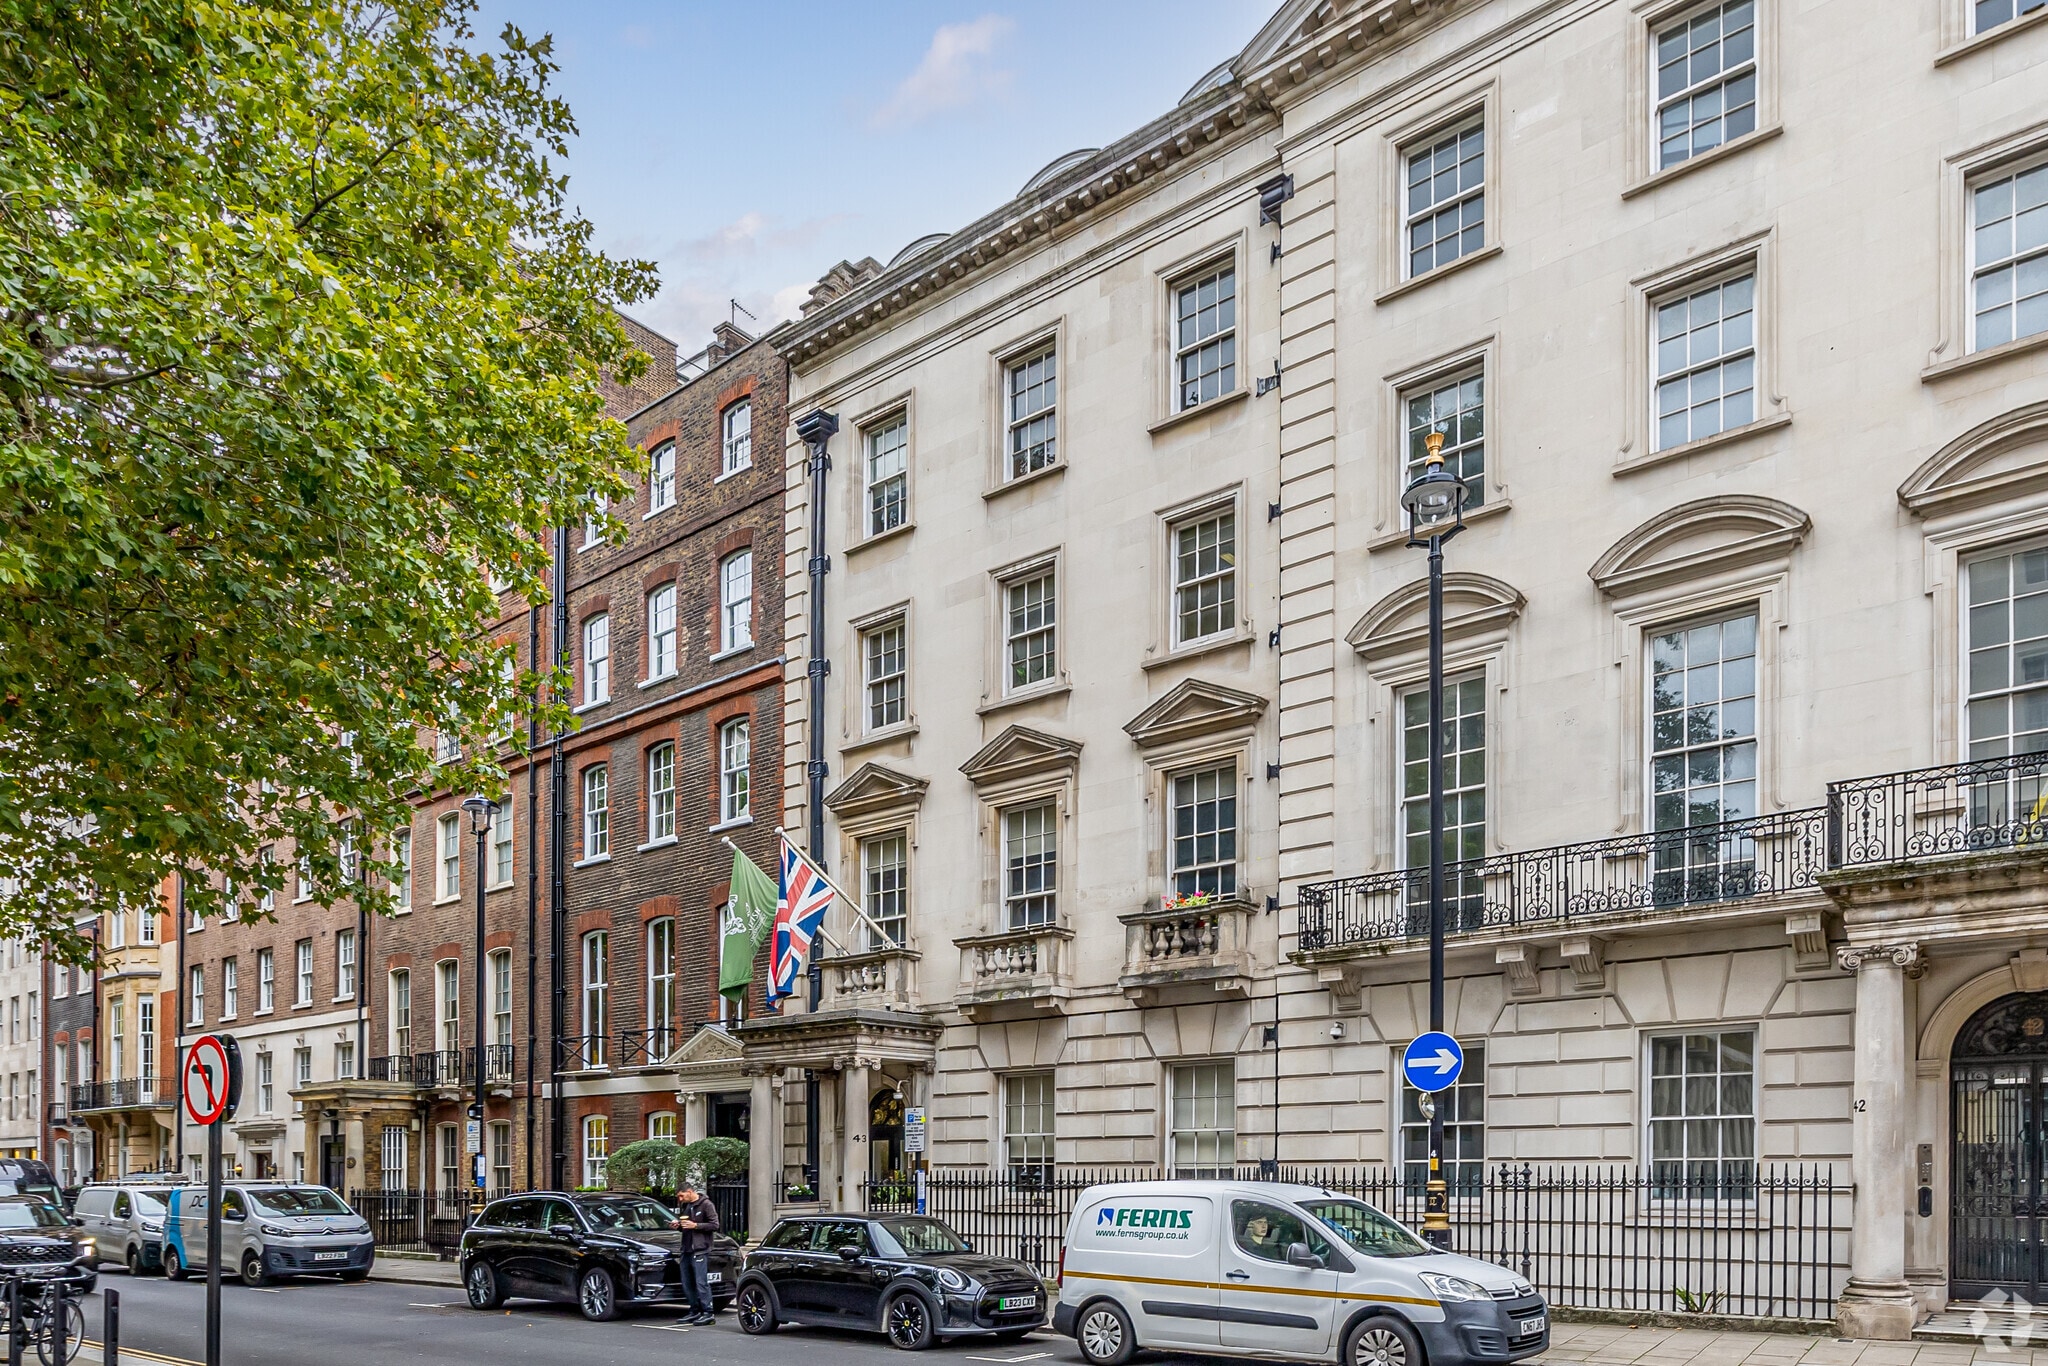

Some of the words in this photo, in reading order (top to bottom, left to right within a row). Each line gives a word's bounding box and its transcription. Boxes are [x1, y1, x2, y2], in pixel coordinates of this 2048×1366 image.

[1853, 1099, 1866, 1113] 42
[852, 1134, 867, 1142] 43
[1115, 1208, 1193, 1229] FERNS
[1095, 1228, 1189, 1240] www.fernsgroup.co.uk
[1004, 1299, 1021, 1308] LB23
[1523, 1320, 1535, 1333] CN67
